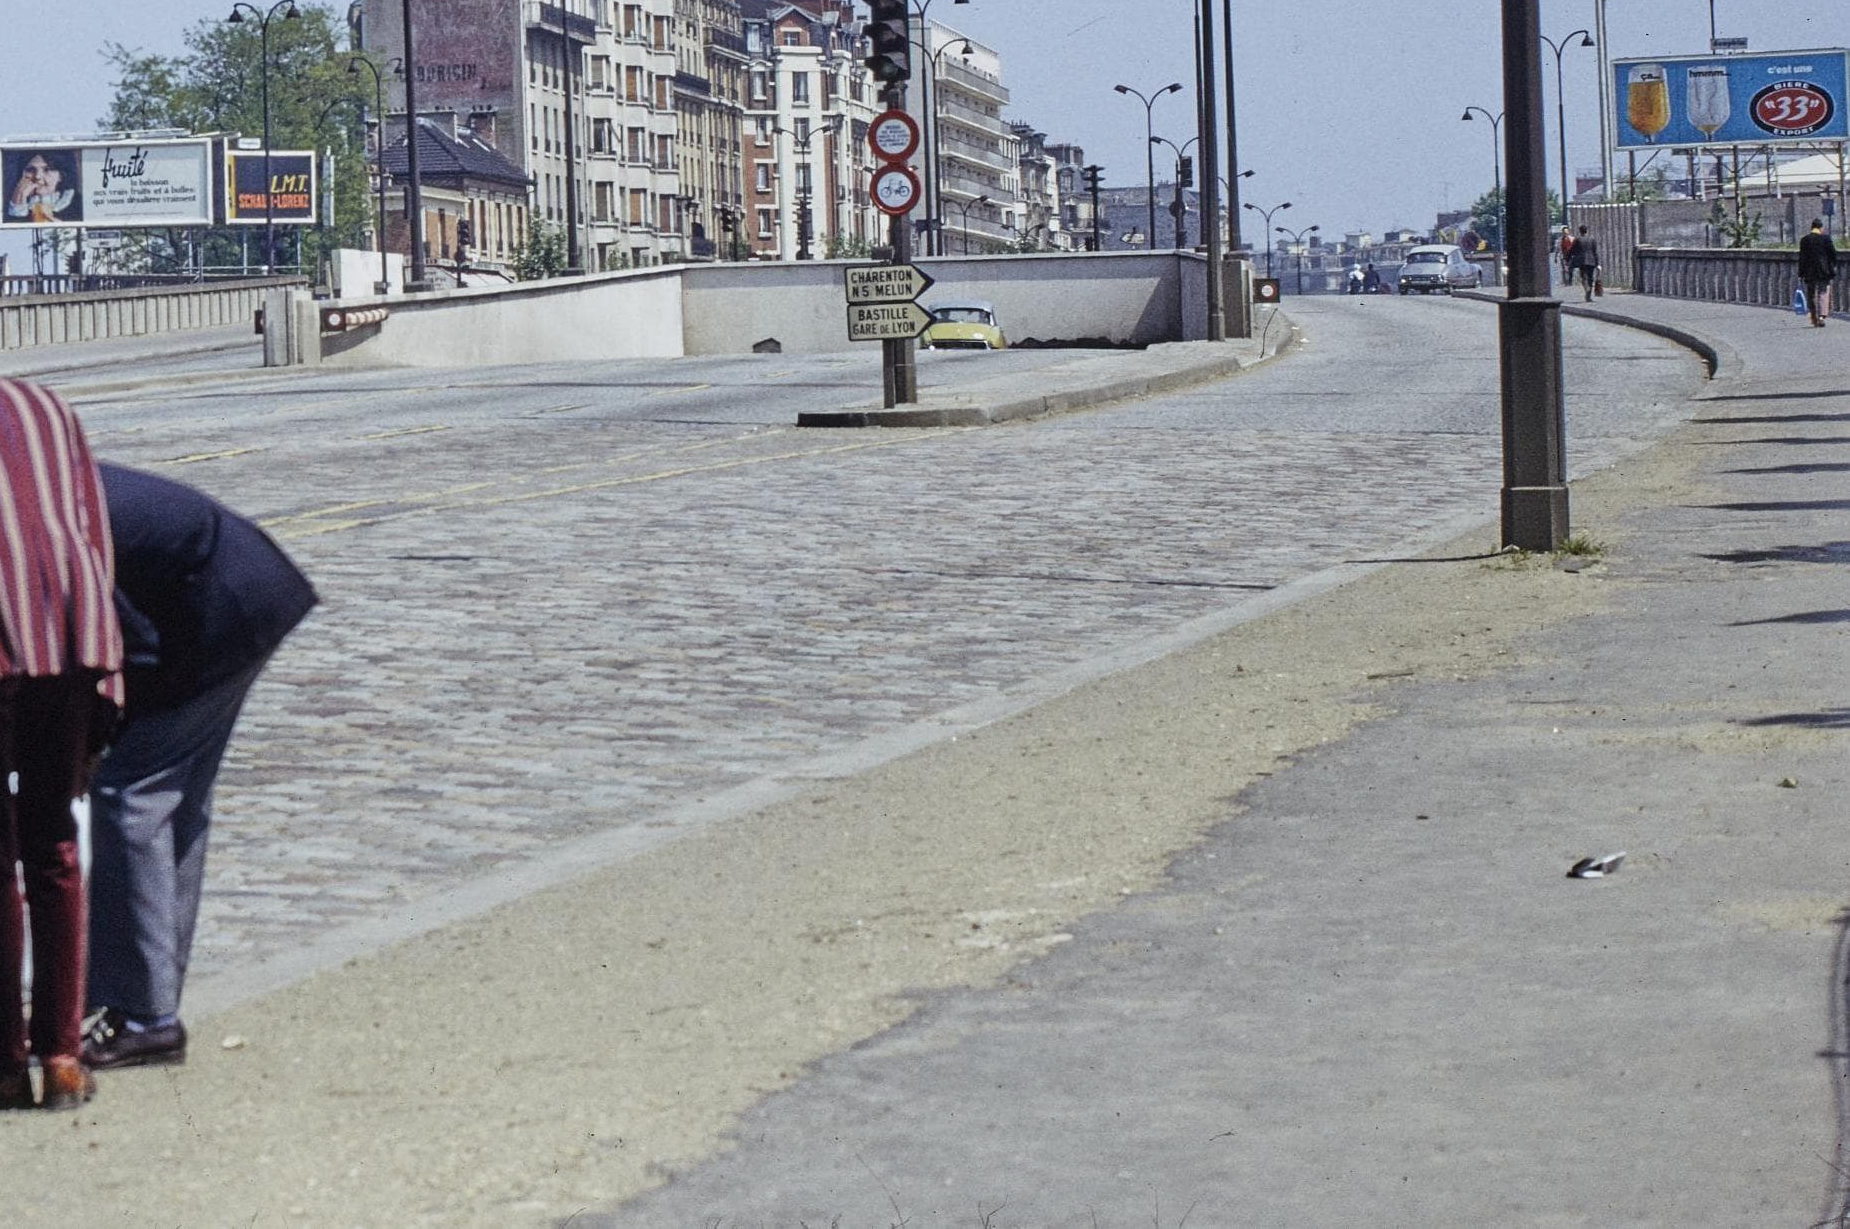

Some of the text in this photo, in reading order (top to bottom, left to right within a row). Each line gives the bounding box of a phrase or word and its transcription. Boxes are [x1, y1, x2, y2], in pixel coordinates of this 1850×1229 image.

[1767, 65, 1792, 74] c'est
[1773, 126, 1814, 136] EXPORT
[100, 146, 148, 188] fruité
[851, 270, 912, 283] CHARENTON
[875, 283, 912, 296] MELUN
[858, 307, 909, 321] BASTILLE
[852, 323, 877, 335] GARE
[892, 321, 915, 334] LYON
